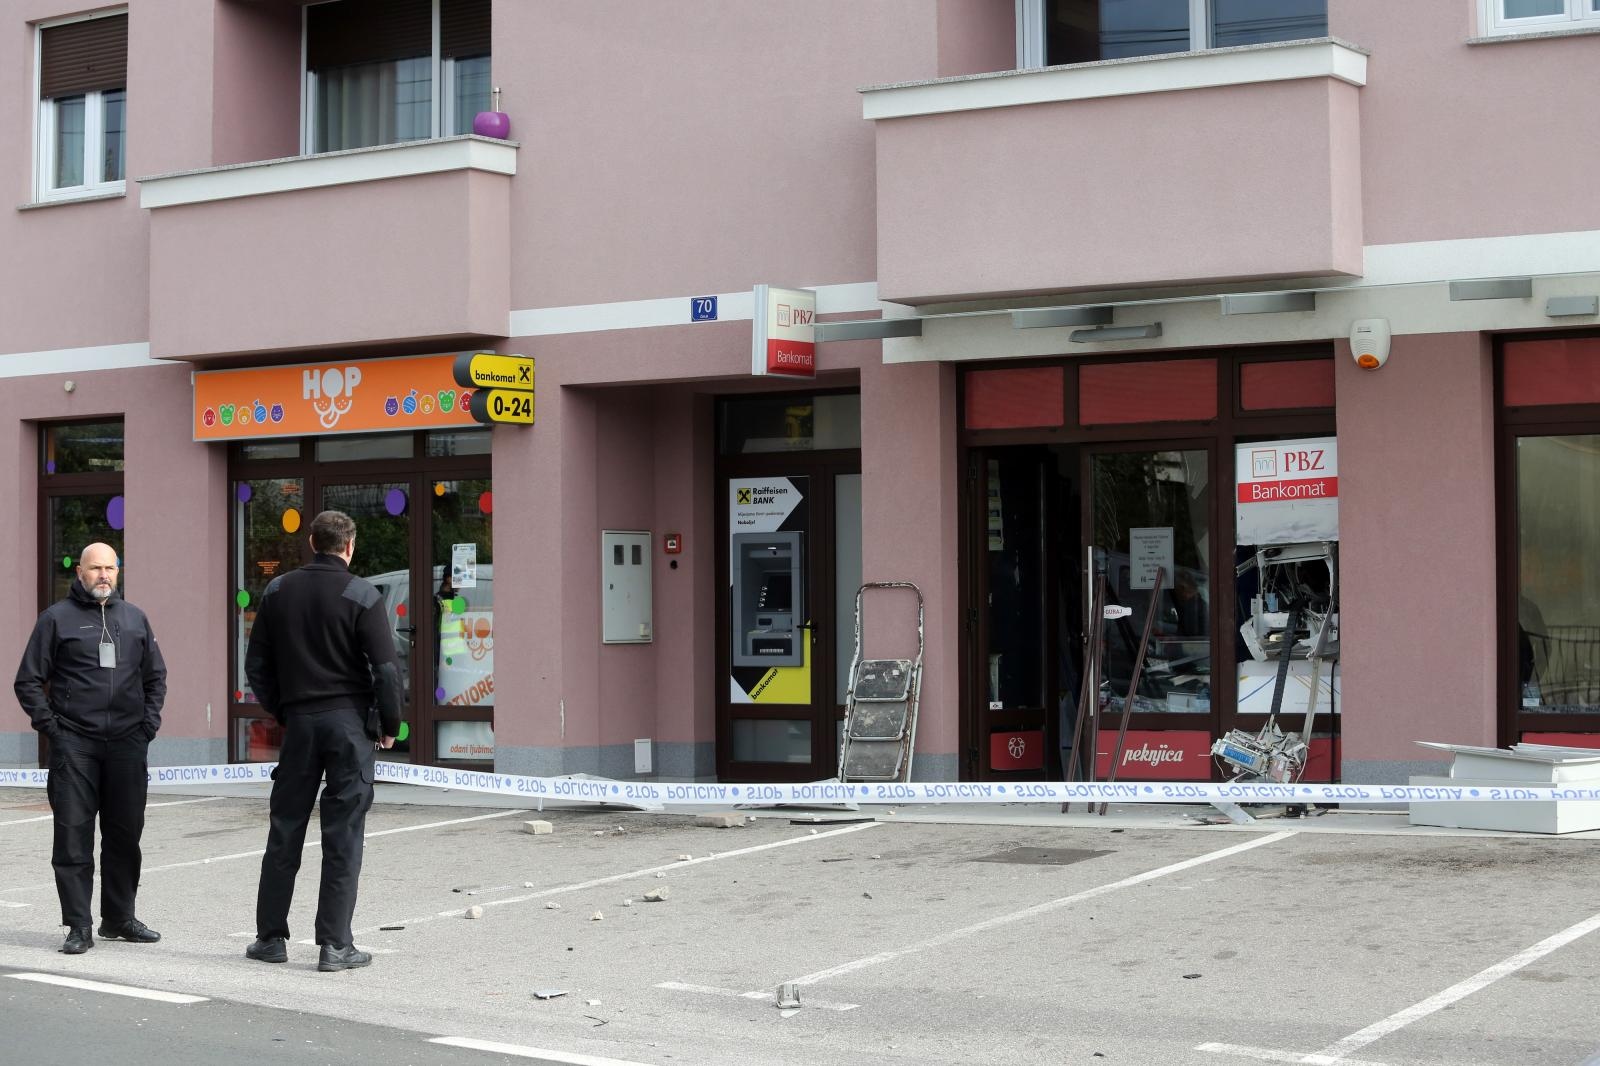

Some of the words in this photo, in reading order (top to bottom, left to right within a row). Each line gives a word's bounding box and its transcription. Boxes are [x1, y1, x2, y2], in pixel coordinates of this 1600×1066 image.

[697, 299, 712, 313] 70
[793, 309, 814, 325] PBZ
[777, 350, 813, 366] Bankomat
[303, 366, 362, 400] HOP
[475, 369, 516, 383] bankomat
[494, 396, 532, 418] 0-24
[1284, 449, 1325, 472] PBZ
[752, 487, 788, 495] Raiffeisen
[1252, 481, 1326, 500] Bankomat
[753, 497, 775, 505] BANK
[751, 668, 779, 700] bankomat
